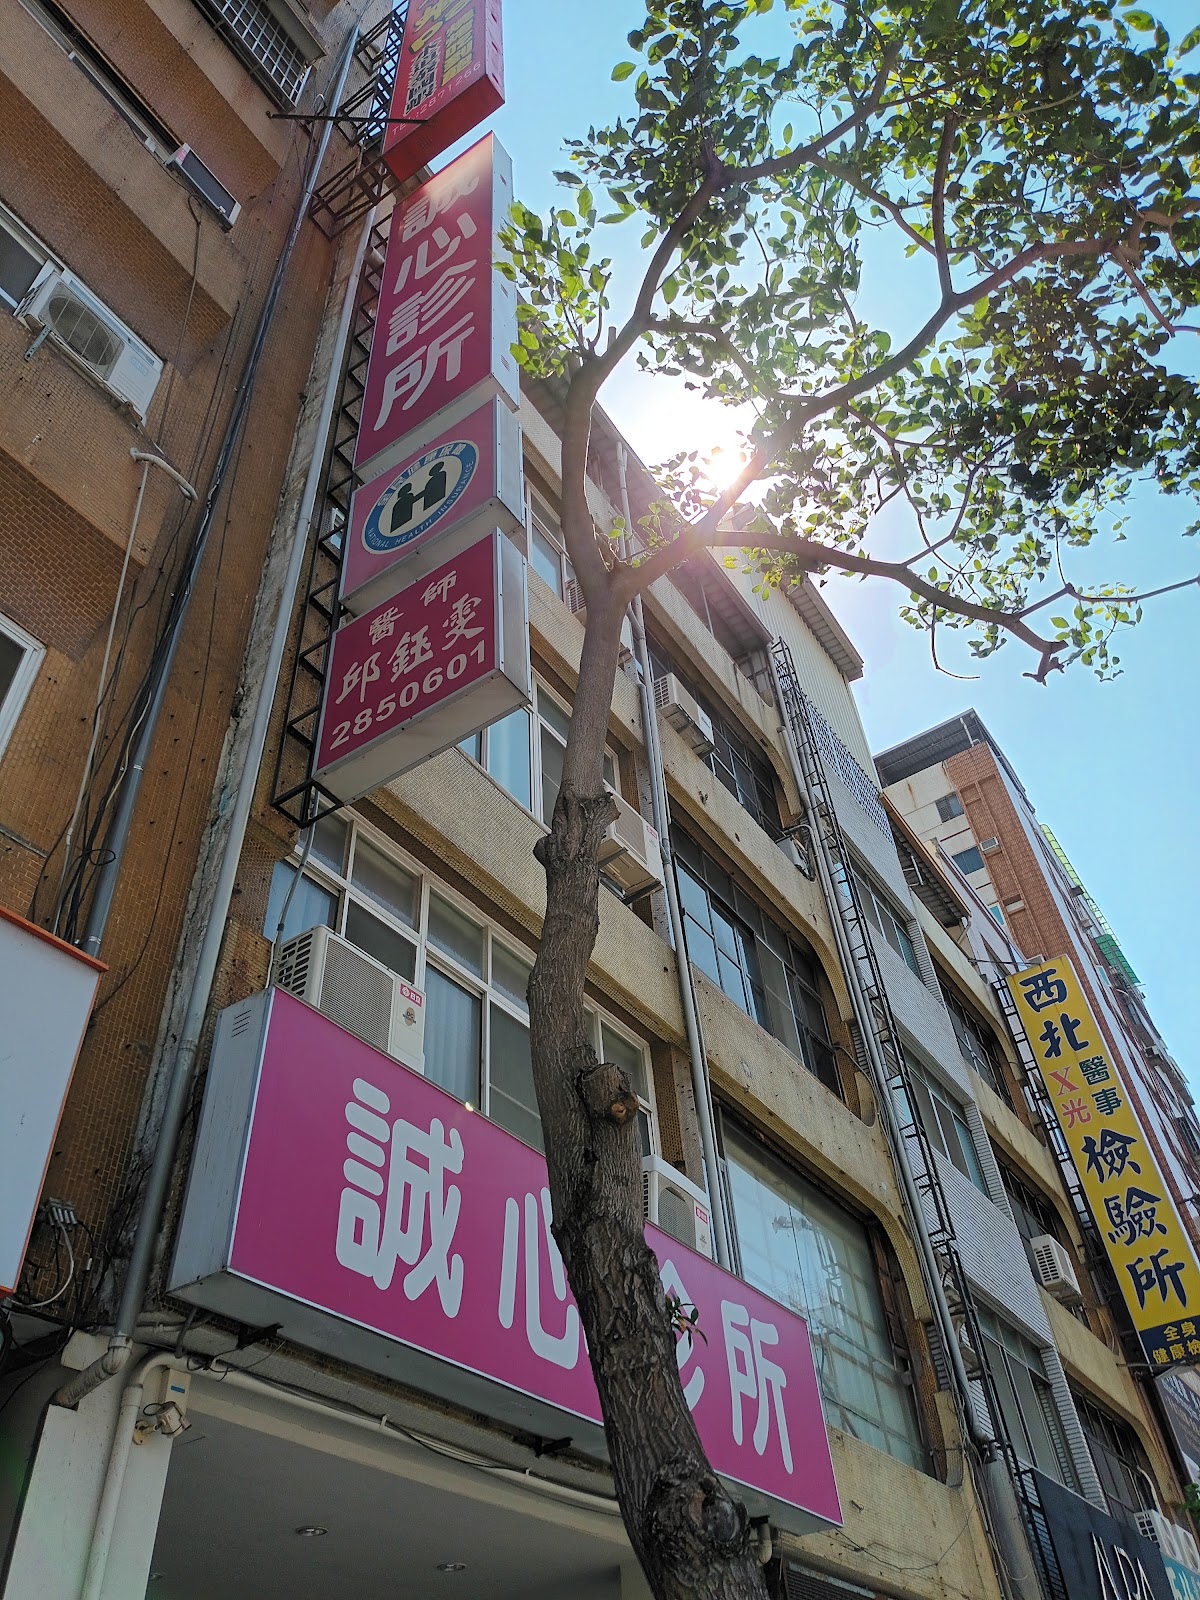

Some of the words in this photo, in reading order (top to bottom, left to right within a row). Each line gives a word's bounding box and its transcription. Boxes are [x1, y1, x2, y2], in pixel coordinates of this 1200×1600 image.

[374, 174, 480, 431] 誠心診所
[367, 528, 389, 548] NATIONAL
[395, 519, 432, 545] HEALTH
[438, 460, 474, 515] INSURANCE
[335, 593, 485, 704] 邱鈺雯
[369, 570, 457, 645] 醫師
[330, 640, 485, 750] 2850601
[1019, 968, 1089, 1059] 西北
[1078, 1055, 1123, 1116] 醫事
[1081, 1128, 1185, 1311] 檢驗所
[1163, 1321, 1196, 1342] 全身
